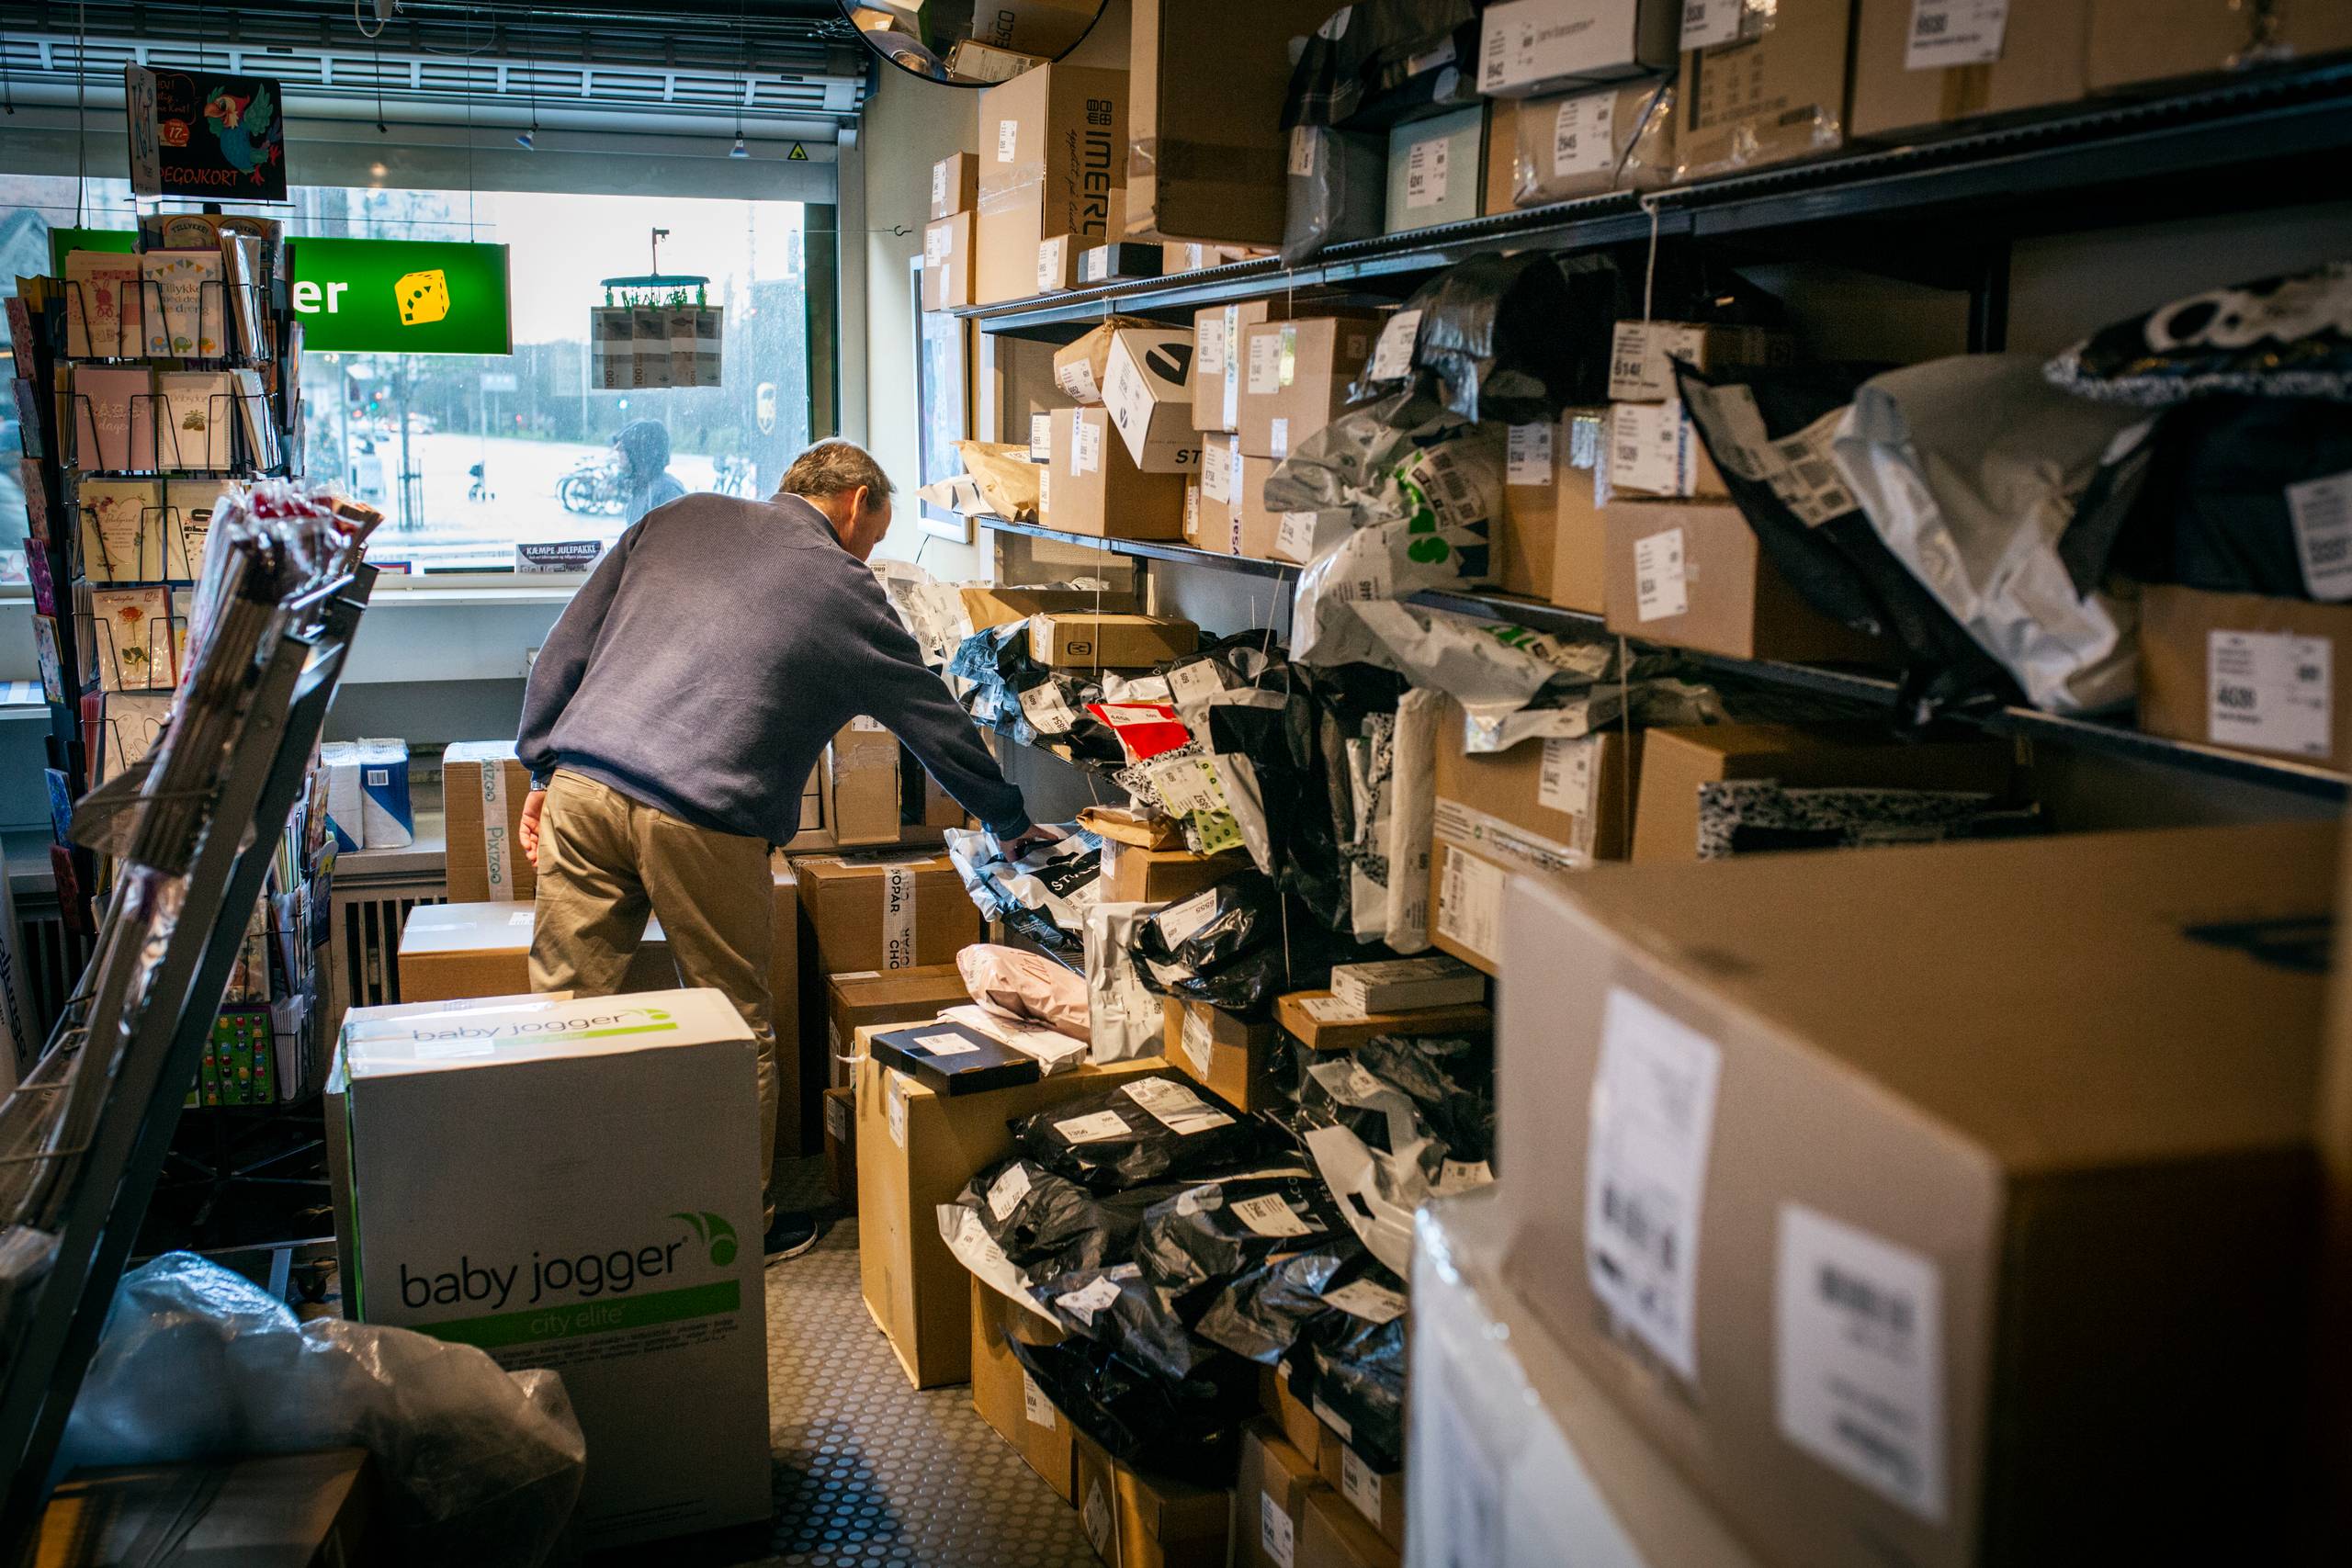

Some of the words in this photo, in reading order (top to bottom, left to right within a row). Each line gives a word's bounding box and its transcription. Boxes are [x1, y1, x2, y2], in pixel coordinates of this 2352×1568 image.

[526, 547, 555, 555] KÆMPE
[557, 545, 596, 555] JULEPAKKE
[1181, 672, 1190, 684] 609
[1029, 694, 1037, 705] 609
[413, 1025, 500, 1042] baby
[508, 1012, 627, 1035] jogger
[401, 1256, 518, 1310] baby
[529, 1240, 684, 1304] jogger
[530, 1309, 571, 1336] city
[576, 1303, 626, 1329] elite
